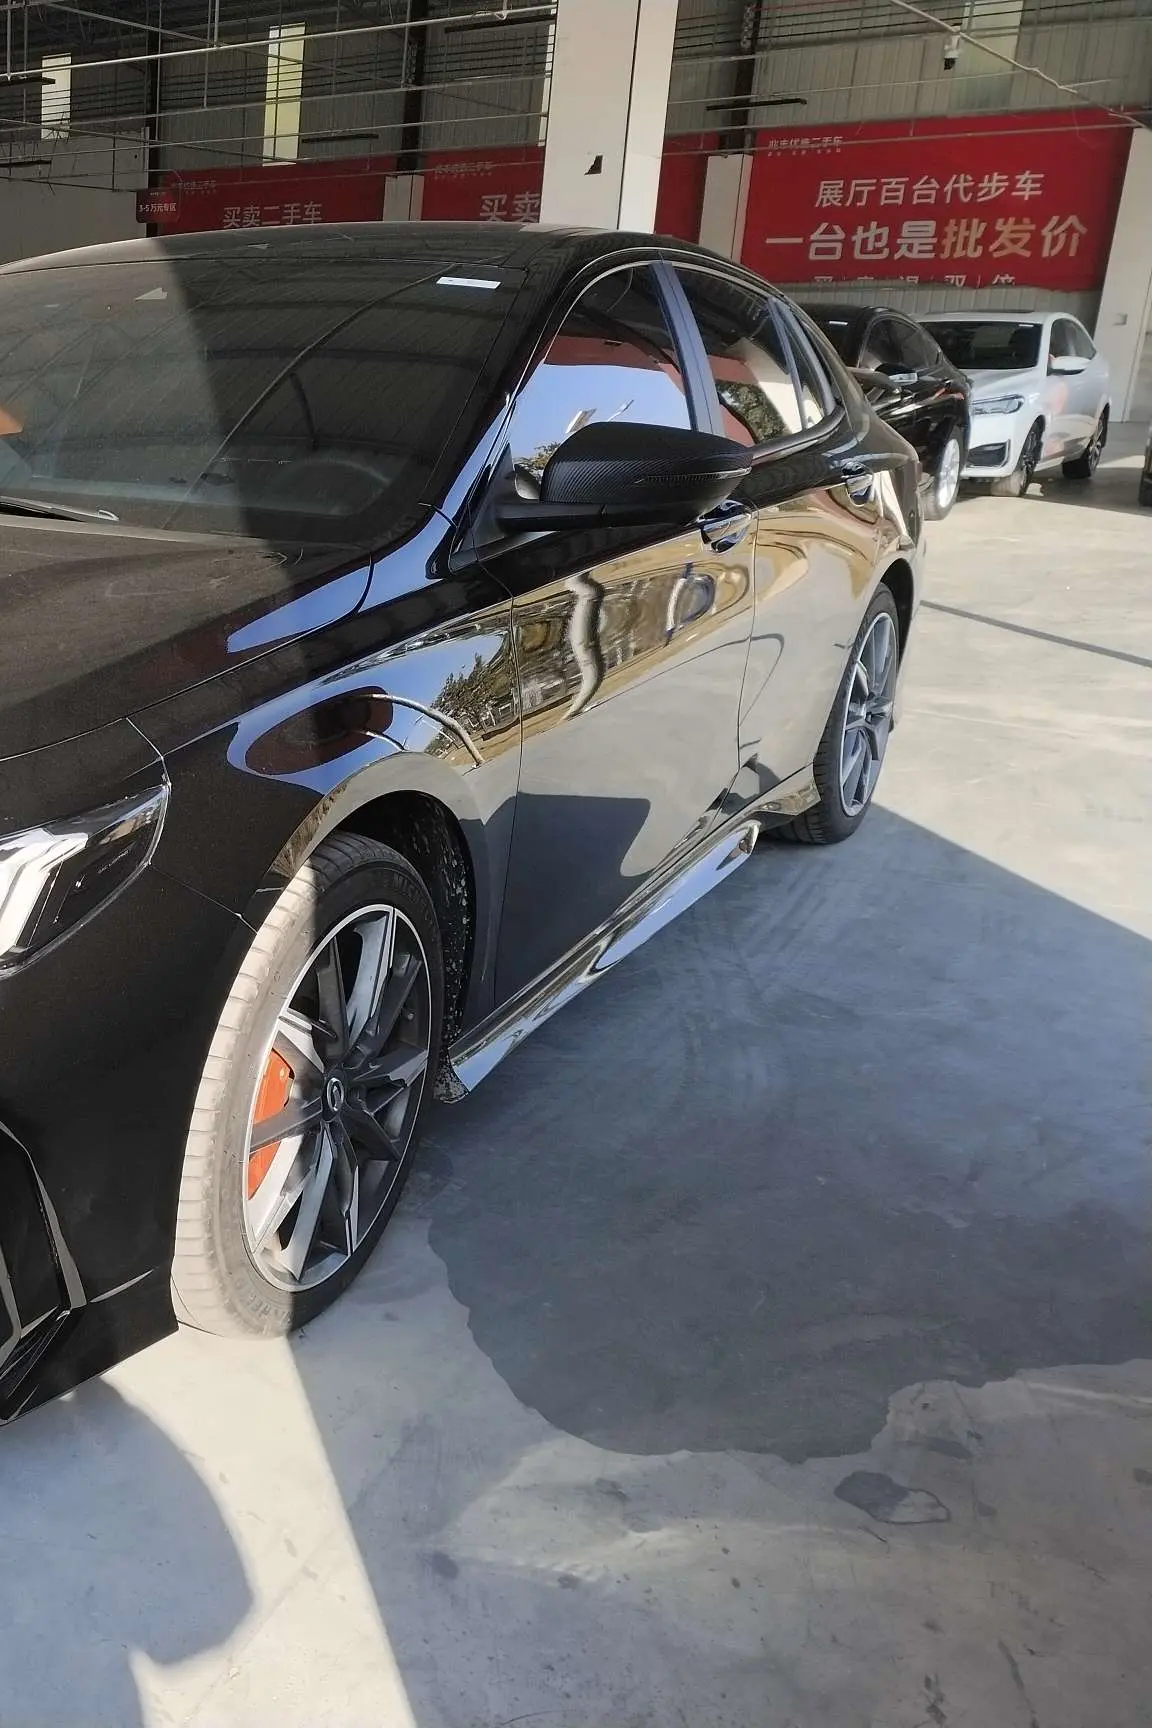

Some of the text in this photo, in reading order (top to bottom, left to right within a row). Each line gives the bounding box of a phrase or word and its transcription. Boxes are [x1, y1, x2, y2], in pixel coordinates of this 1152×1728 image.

[814, 170, 1045, 208] 展厅百台代步车
[223, 201, 323, 228] 买卖二手车
[766, 214, 1088, 261] 一台也是批发价
